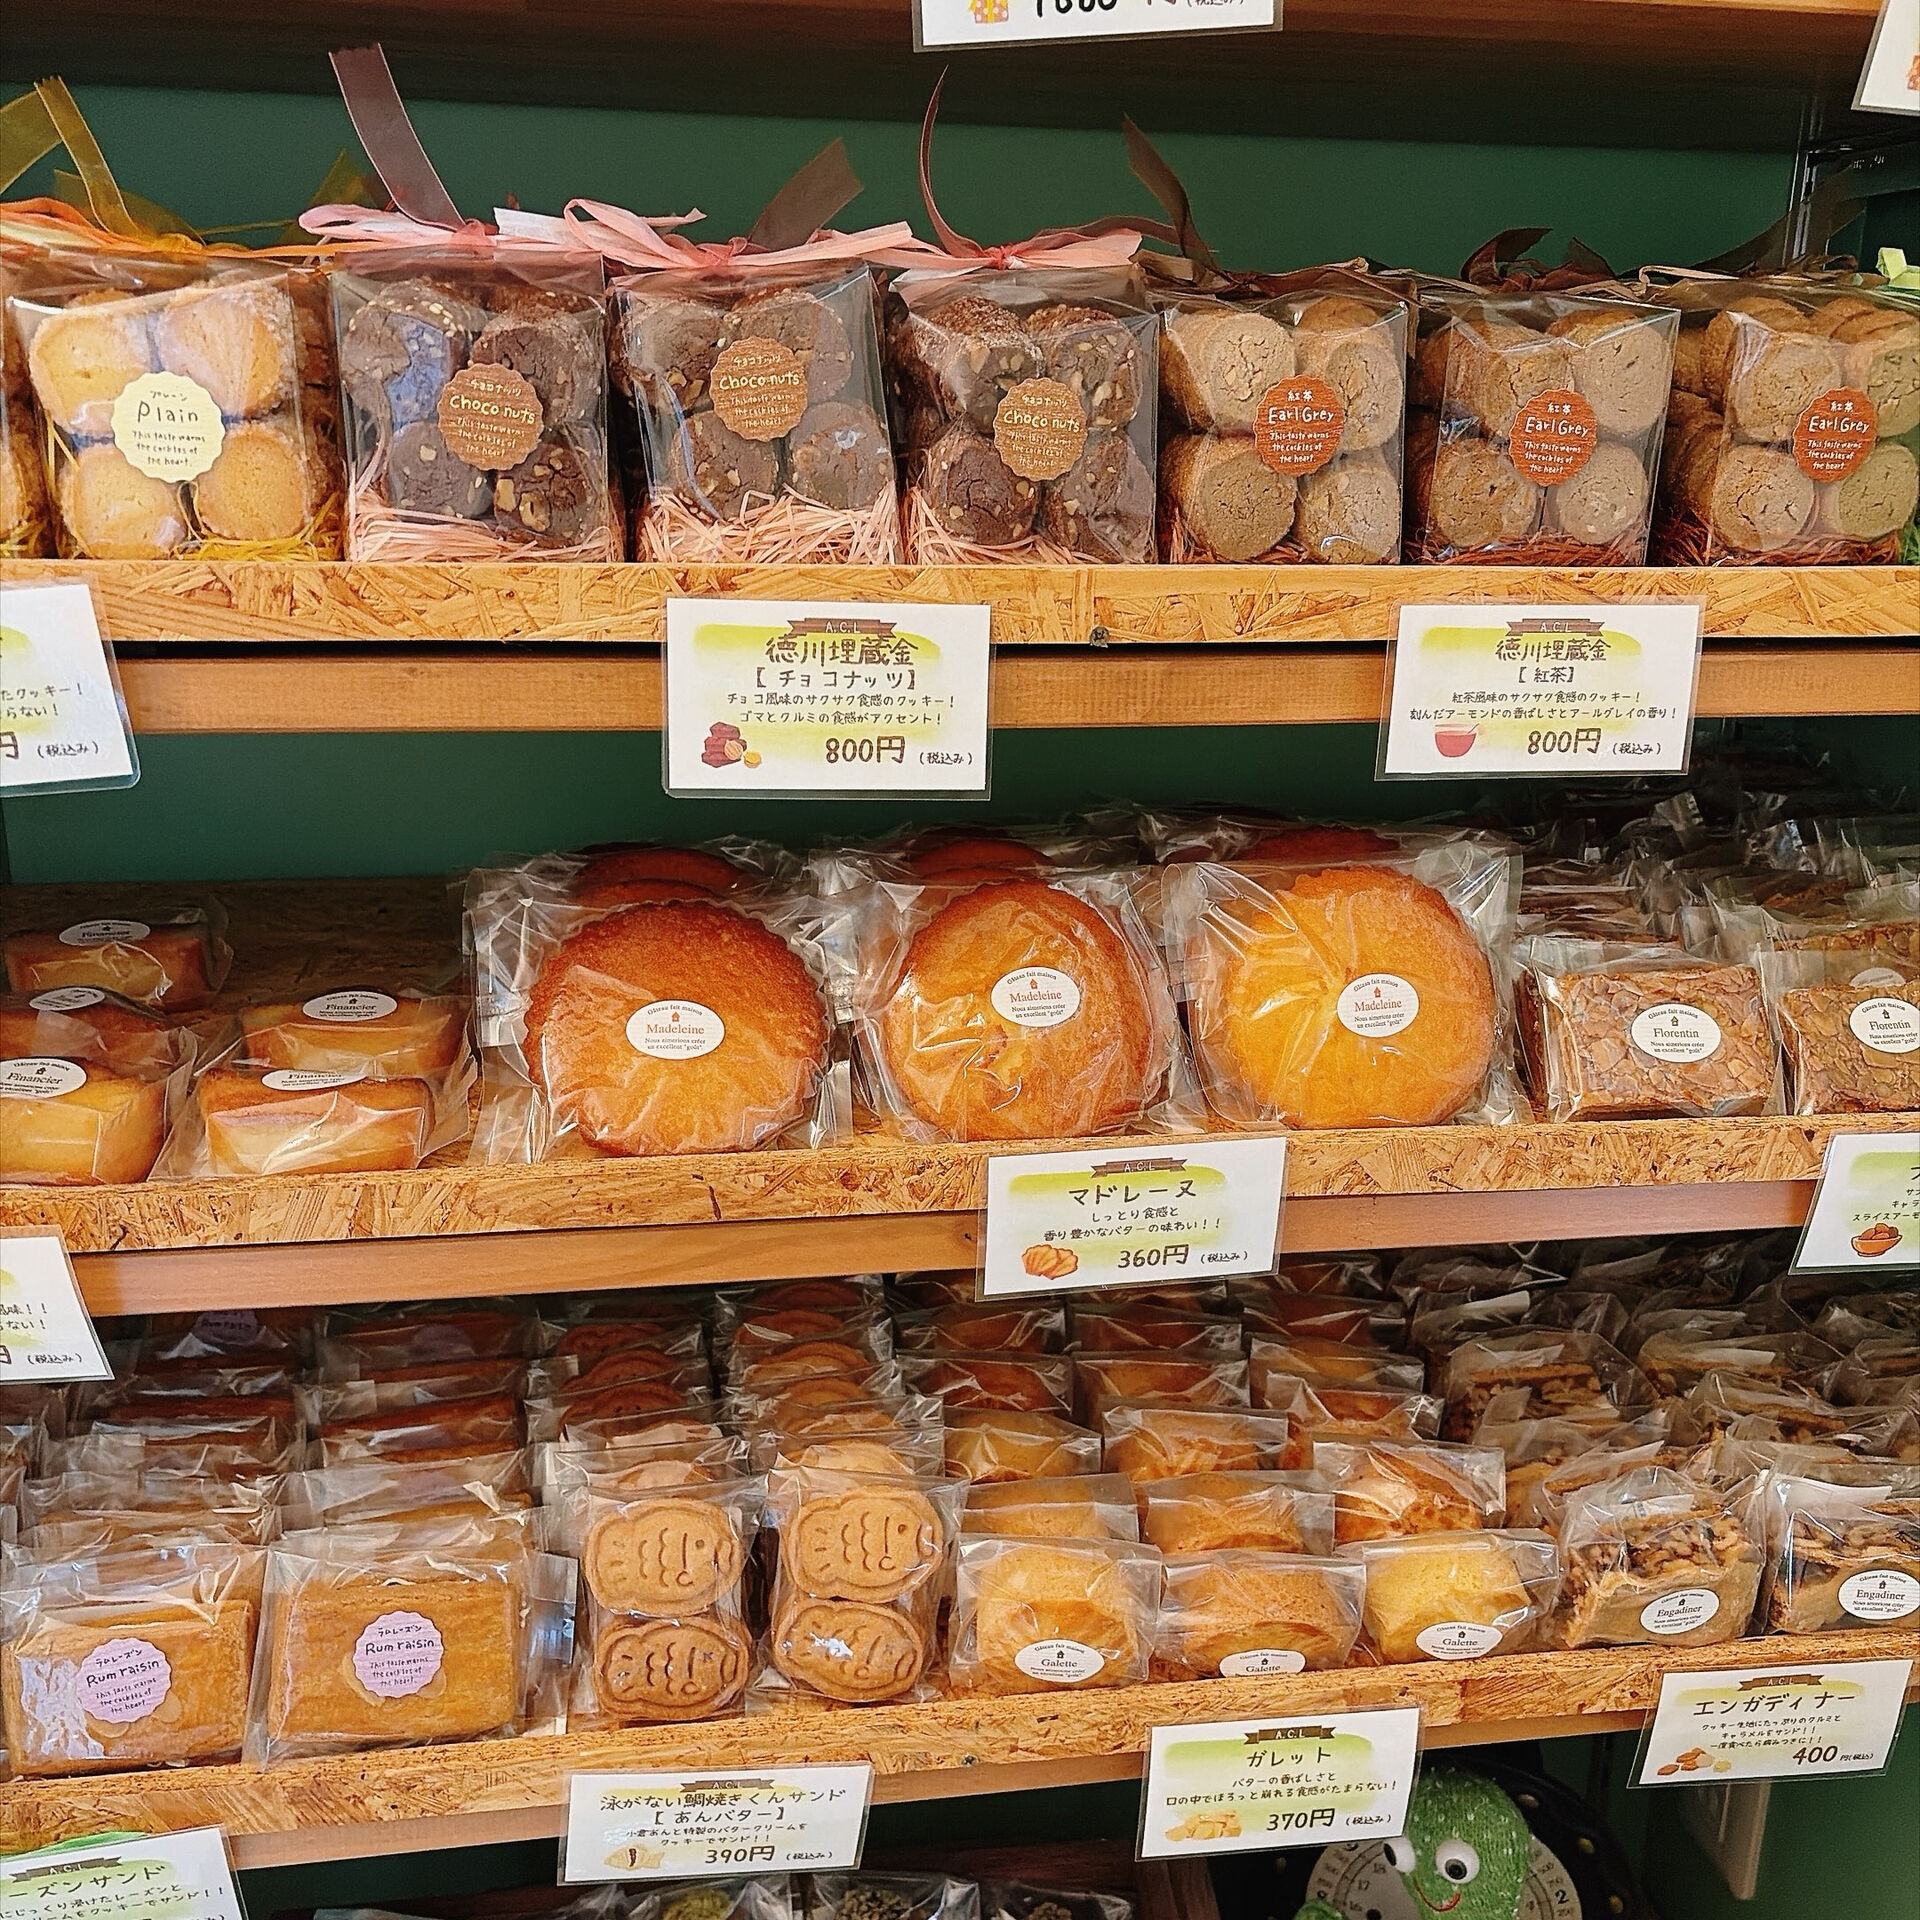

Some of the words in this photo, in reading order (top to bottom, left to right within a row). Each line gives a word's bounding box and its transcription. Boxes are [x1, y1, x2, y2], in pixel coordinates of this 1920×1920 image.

[770, 371, 799, 385] nuts
[1288, 390, 1313, 401] 紅茶
[138, 401, 198, 422] Plain
[1547, 403, 1571, 415] 紅茶
[1831, 401, 1853, 412] 紅茶
[504, 406, 535, 424] nuts
[1269, 406, 1298, 424] Earl
[1302, 406, 1334, 422] Grey
[1052, 418, 1079, 432] nuts
[1525, 417, 1555, 433] Earl
[1558, 420, 1588, 437] Grey
[1809, 416, 1837, 432] Earl
[1840, 418, 1869, 433] Grey
[132, 431, 151, 440] This
[1270, 432, 1285, 440] This
[1524, 441, 1539, 449] This
[1808, 440, 1821, 448] This
[765, 635, 918, 666] 徳川埋蔵金
[1496, 638, 1611, 663] 徳川埋蔵金
[757, 667, 917, 690] 【チョコナッツ】
[1518, 667, 1574, 683] 【紅茶】
[727, 693, 955, 708] チョコ風味のサクサク食感のクッキー！
[1452, 691, 1640, 704] 紅茶風味のサクサク食感のクッキー！
[0, 704, 58, 720] らない！
[739, 712, 941, 726] ゴマとクルミの食感がアクセント！
[1410, 706, 1676, 720] 刻んだアーモンドの香ばしさとアールグレイの香り！
[1528, 728, 1601, 755] 800円
[1612, 742, 1661, 755] （税込み）
[37, 742, 98, 759] （税込み）
[825, 736, 905, 764] 800円
[919, 752, 972, 766] （税込み）
[1010, 991, 1062, 1003] Madeleine
[1355, 999, 1402, 1012] Madeleine
[647, 1024, 704, 1034] Madeleine
[1869, 1020, 1911, 1030] Florentin
[1653, 1028, 1699, 1038] Florentin
[6, 1072, 62, 1085] Financier
[1069, 1179, 1197, 1207] マドレーヌ
[1092, 1207, 1179, 1223] しっとり食感と
[1043, 1218, 1221, 1242] 香り豊かなバターの味わい！！
[1118, 1243, 1189, 1269] 360円
[1200, 1251, 1248, 1264] （税込み）
[0, 1320, 46, 1330] ない！
[28, 1353, 82, 1365] （税込み）
[1857, 1590, 1905, 1600] Engadiner
[1657, 1606, 1702, 1617] Engadiner
[378, 1625, 421, 1637] ラムレーズン
[366, 1643, 393, 1655] Rum
[397, 1640, 434, 1650] raisin
[96, 1650, 142, 1667] ラムレーズン
[1041, 1659, 1077, 1668] Galette
[86, 1673, 116, 1688] Rum
[119, 1660, 159, 1676] raisin
[1246, 1665, 1280, 1673] Galette
[1693, 1692, 1855, 1716] エンガディナー
[1702, 1715, 1841, 1731] クッキー生地にたっぷりのクルミと
[1721, 1727, 1816, 1739] キャラメルをサンド！！
[1247, 1747, 1331, 1768] ガレット
[1793, 1745, 1838, 1765] 400
[1233, 1772, 1337, 1788] バターの香ばしさと
[600, 1789, 846, 1811] 泳がない鯛焼きくんサンド
[1166, 1780, 1397, 1806] 口の中でほろっと崩れる食感がたまらない！
[655, 1808, 784, 1825] 【あんバター】
[1266, 1808, 1335, 1831] 370円
[1346, 1815, 1391, 1826] （税込み）
[661, 1834, 770, 1846] クッキーでサンド！！
[705, 1846, 775, 1864] 390円
[786, 1851, 833, 1861] （税込み）
